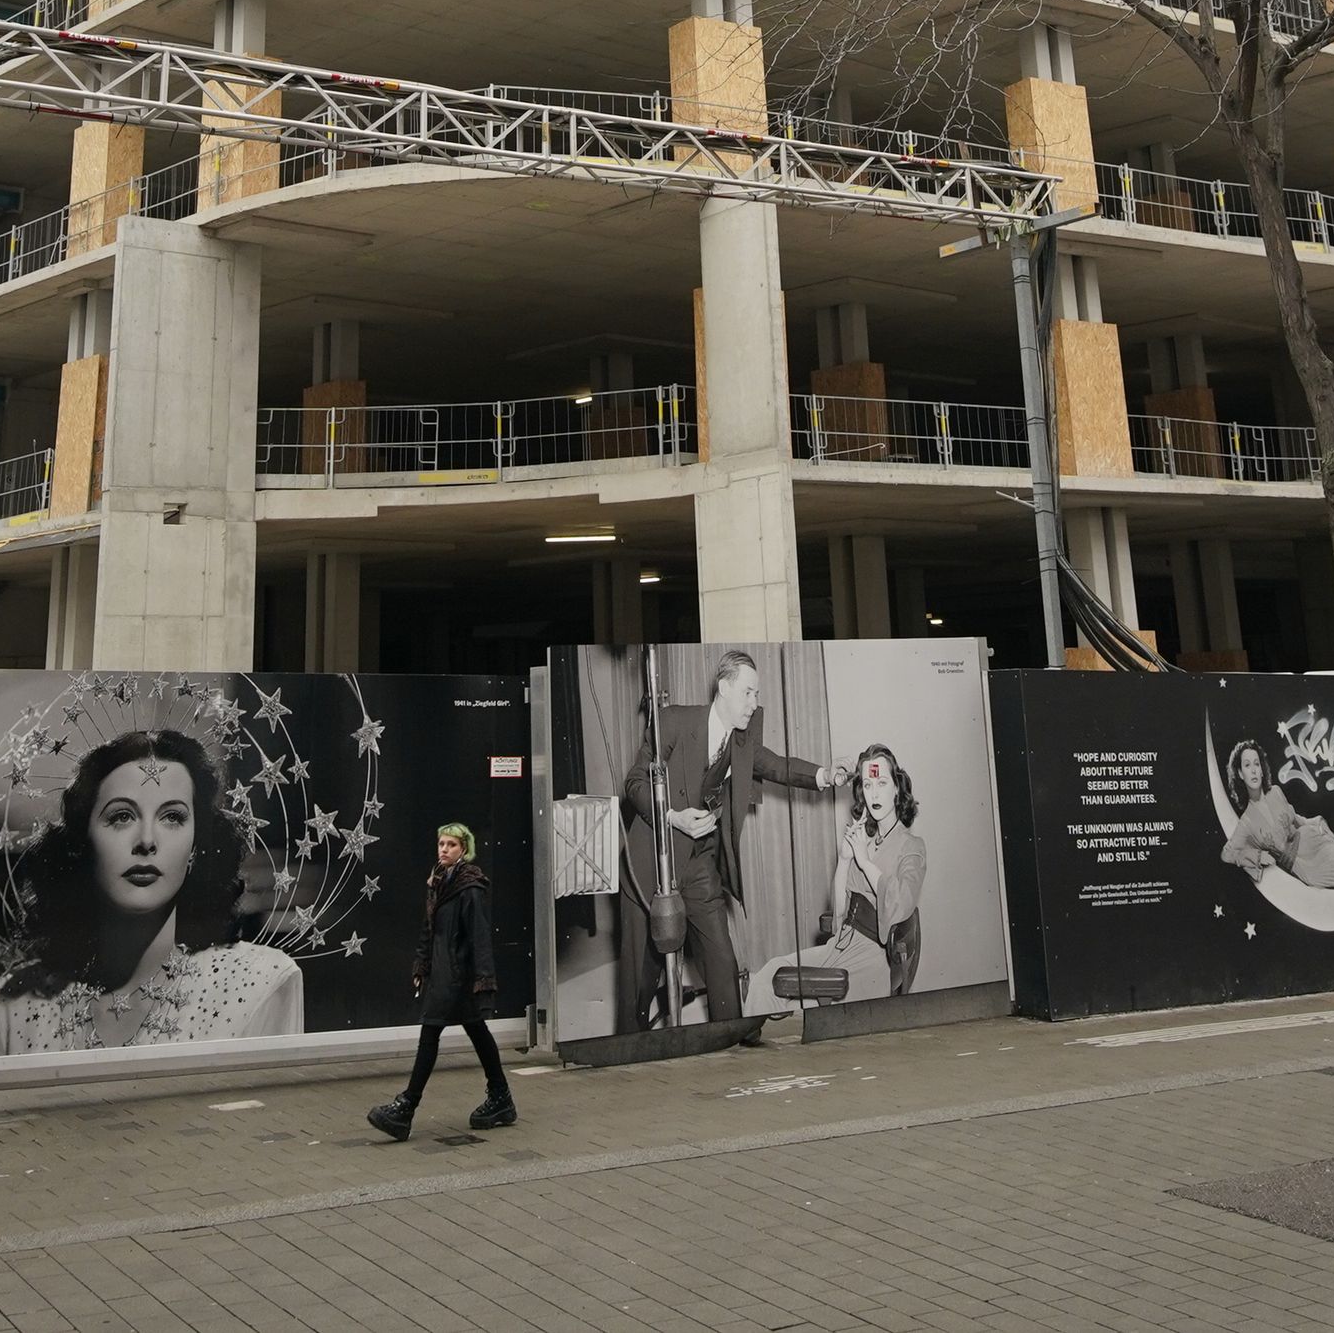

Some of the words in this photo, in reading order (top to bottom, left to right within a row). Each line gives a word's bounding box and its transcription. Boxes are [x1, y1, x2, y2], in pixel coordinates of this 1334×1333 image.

[1100, 752, 1117, 762] AND
[1118, 752, 1158, 762] CURIOSITY
[1080, 766, 1107, 777] ABOUT
[1107, 766, 1123, 776] THE
[1124, 766, 1154, 776] FUTURE
[1087, 781, 1119, 791] SEEMED
[1120, 780, 1149, 790] BETTER
[1080, 795, 1103, 805] THAN
[1104, 794, 1157, 805] GUARANTEES.
[1067, 825, 1083, 835] THE
[1084, 823, 1125, 834] UNKNOWN
[1126, 822, 1143, 833] WAS
[1144, 821, 1174, 832] ALWAYS
[1076, 839, 1088, 849] SO
[1089, 837, 1136, 848] ATTRACTIVE
[1137, 836, 1148, 846] TO
[1148, 836, 1160, 846] ME
[1097, 853, 1114, 863] AND
[1115, 851, 1136, 862] STILL
